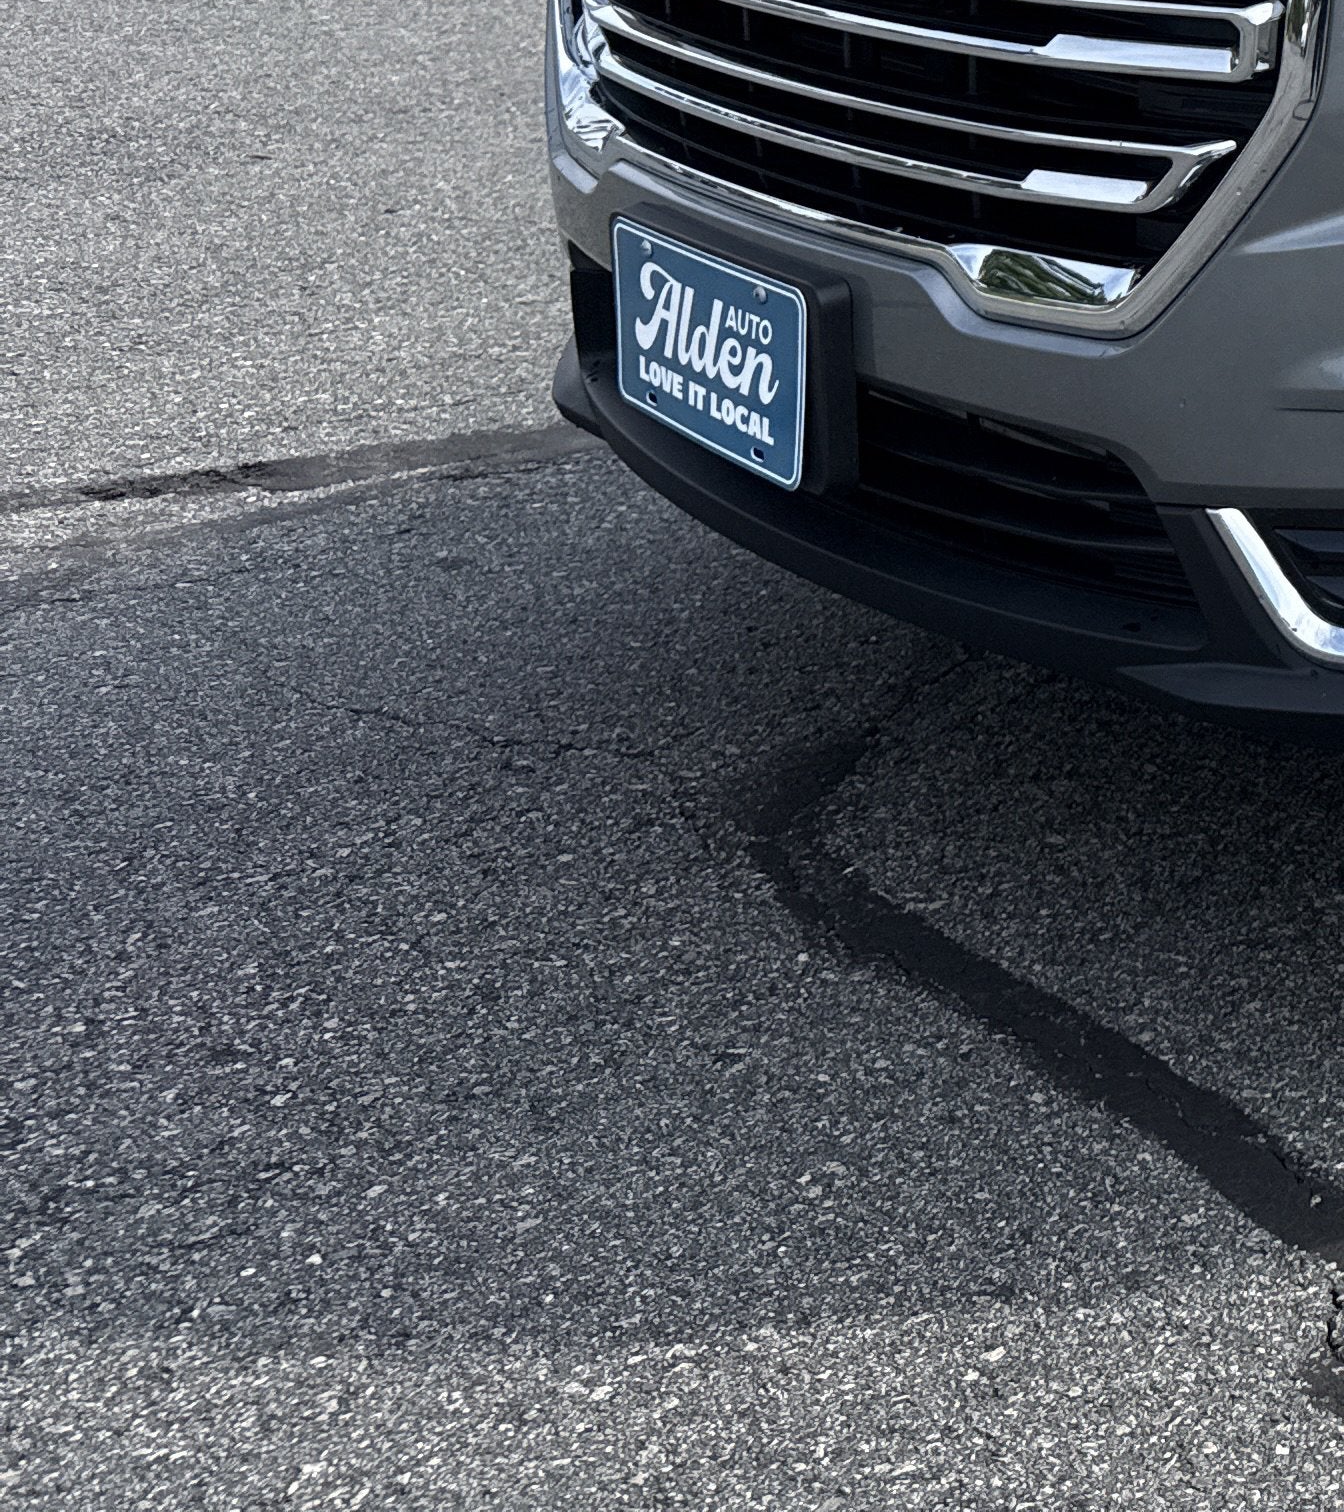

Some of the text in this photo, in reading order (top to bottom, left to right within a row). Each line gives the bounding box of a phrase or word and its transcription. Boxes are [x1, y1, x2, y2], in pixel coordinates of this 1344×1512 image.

[634, 261, 780, 405] Alden
[725, 305, 773, 346] AUTO
[638, 354, 775, 446] LOVE IT LOCAL
